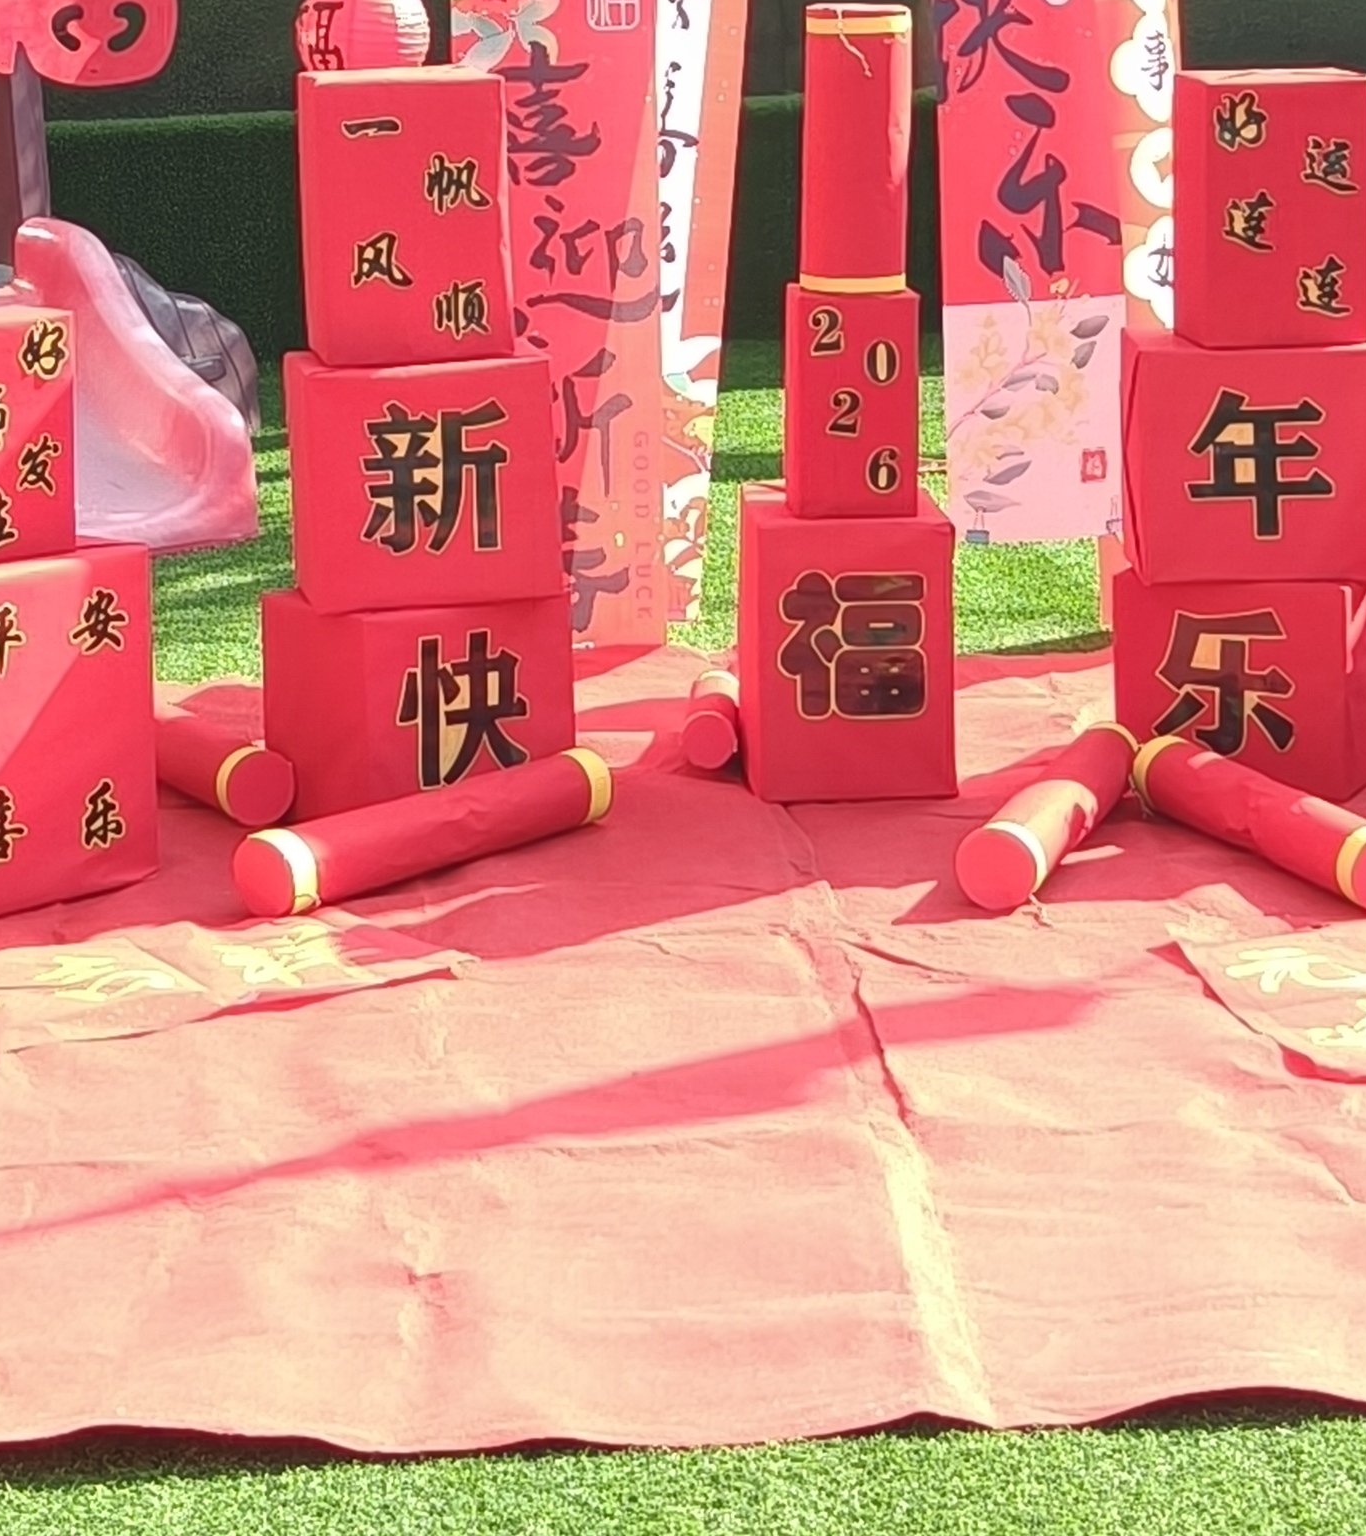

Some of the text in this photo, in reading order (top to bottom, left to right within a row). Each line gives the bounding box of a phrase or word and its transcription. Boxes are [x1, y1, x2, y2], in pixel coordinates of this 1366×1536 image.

[341, 115, 491, 337] 一帆风顺
[1212, 90, 1360, 318] 好运连连
[359, 400, 510, 555] 新
[808, 305, 902, 495] 2026
[1183, 387, 1335, 541] 年
[633, 430, 653, 620] GOOD LUCK
[396, 629, 529, 790] 快
[777, 569, 927, 720] 福
[1152, 607, 1296, 757] 乐
